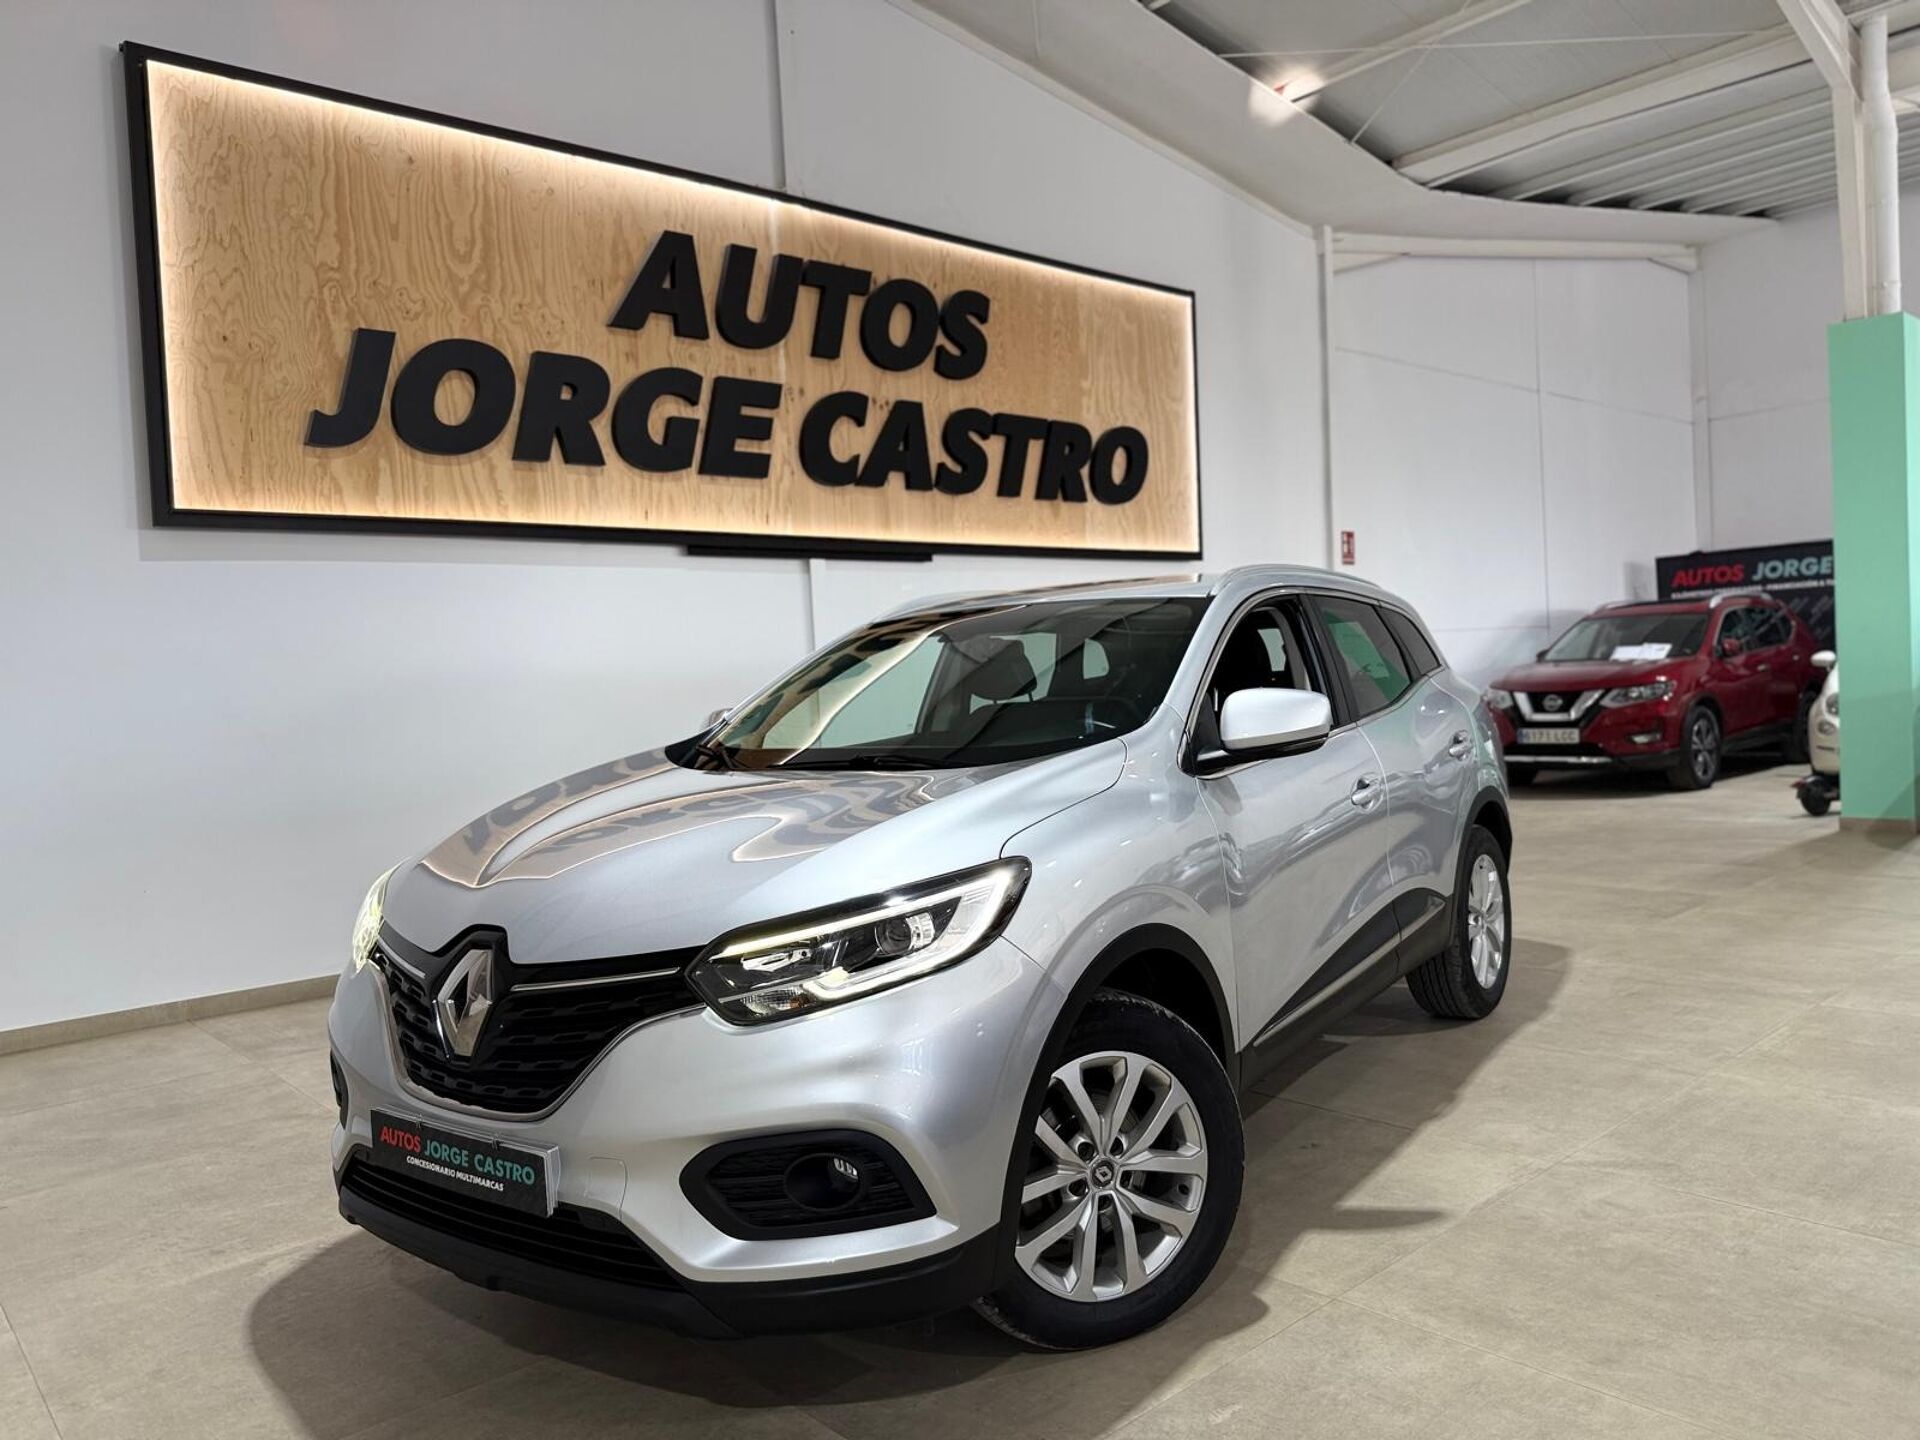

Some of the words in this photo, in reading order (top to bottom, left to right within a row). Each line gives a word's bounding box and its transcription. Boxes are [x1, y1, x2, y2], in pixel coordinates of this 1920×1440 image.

[608, 230, 991, 380] AUTOS
[304, 327, 783, 480] JORGE
[799, 391, 1149, 505] CASTRO
[1672, 564, 1745, 587] AUTOS
[1753, 557, 1833, 580] JORGE
[381, 1127, 421, 1153] AUTOS
[424, 1139, 469, 1167] JORGE
[473, 1153, 535, 1185] CASTRO
[406, 1156, 455, 1178] CONCESIONARIO
[456, 1170, 504, 1191] MULTIMARCAS
